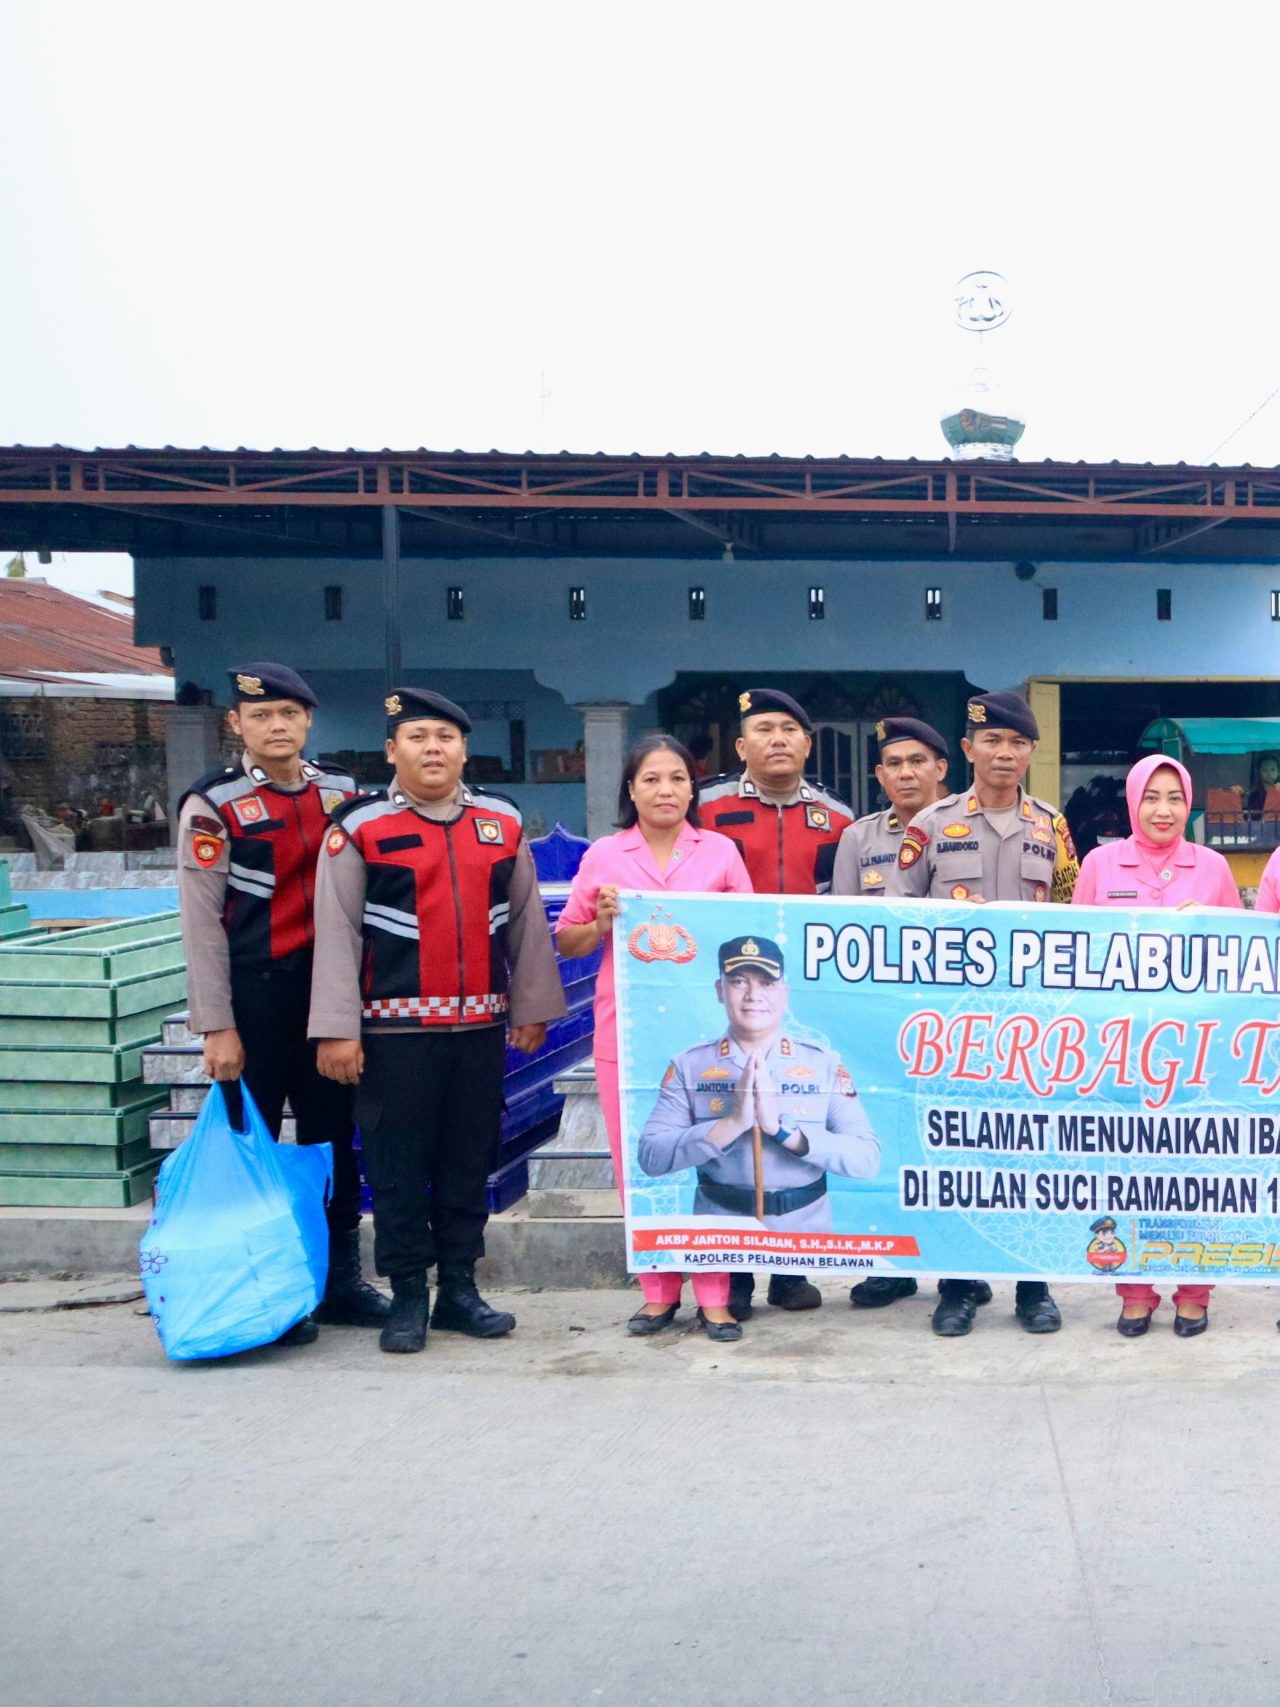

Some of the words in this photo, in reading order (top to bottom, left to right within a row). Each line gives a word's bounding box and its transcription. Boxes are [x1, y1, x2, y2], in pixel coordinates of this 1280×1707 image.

[804, 923, 996, 987] POLRES
[900, 1011, 1219, 1109] BERBAGI
[927, 1109, 1049, 1151] SELAMAT
[1058, 1115, 1240, 1154] MENUNAIKAN
[904, 1169, 928, 1207] DI
[938, 1170, 1026, 1210] BULAN
[1036, 1173, 1097, 1211] SUCI
[1107, 1175, 1258, 1213] RAMADHAN
[656, 1234, 689, 1246] AKBP
[692, 1234, 740, 1246] JANTON
[743, 1236, 797, 1250] SILABAN,
[684, 1253, 744, 1264] KAPOLRES
[748, 1254, 815, 1266] PELABUHAN
[819, 1257, 874, 1268] BELAWAN
